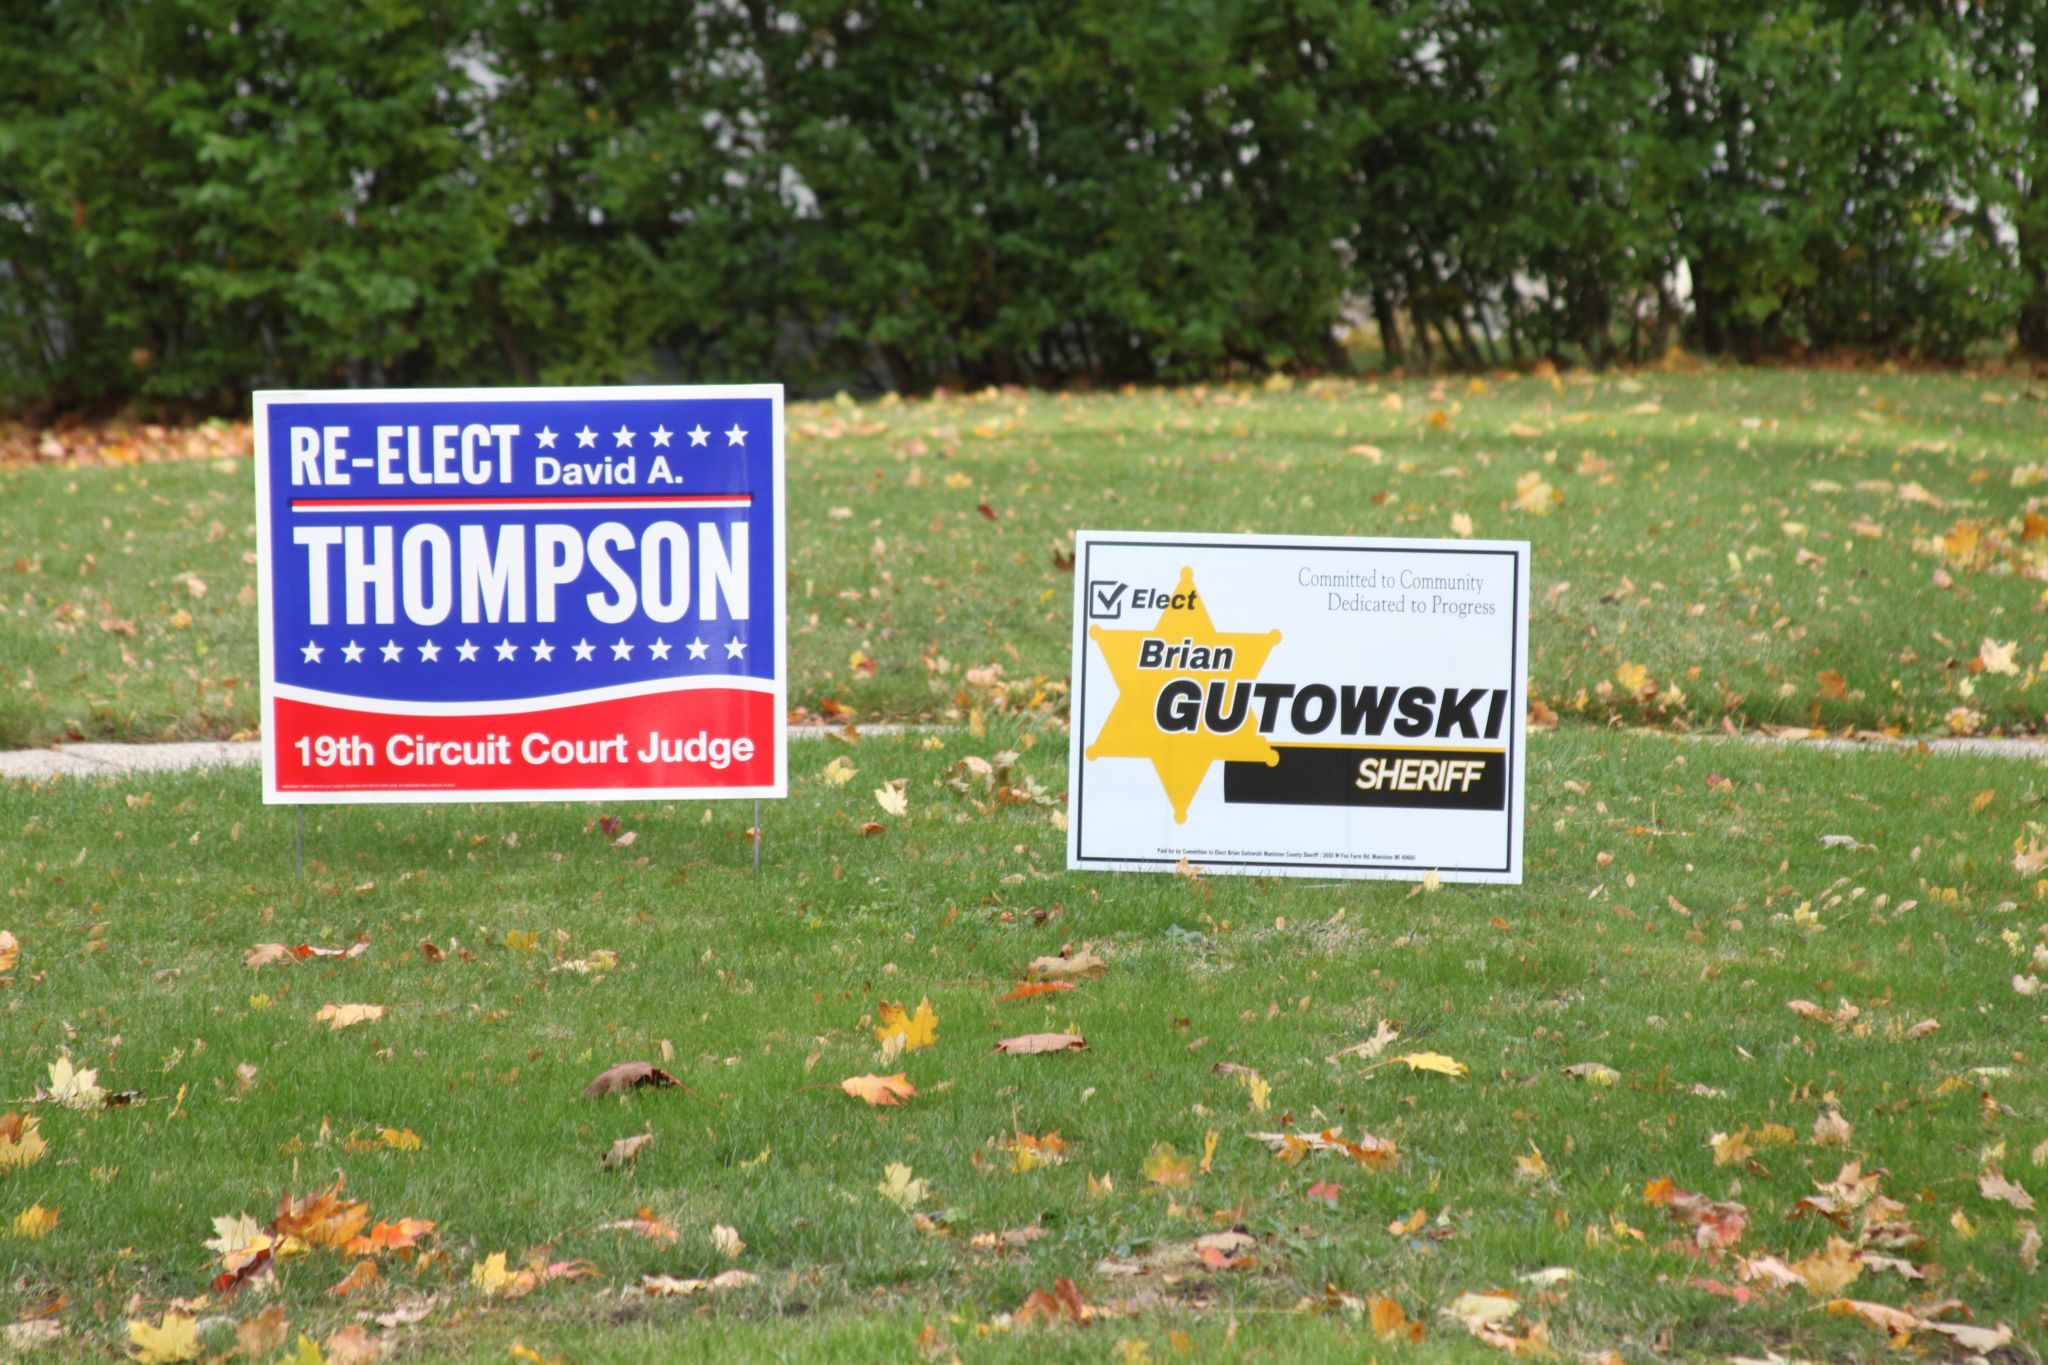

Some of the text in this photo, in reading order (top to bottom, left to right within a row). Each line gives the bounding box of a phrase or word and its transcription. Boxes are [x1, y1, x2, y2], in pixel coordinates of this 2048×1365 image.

[290, 423, 520, 486] RE-ELECT
[535, 455, 683, 485] David A.
[293, 520, 750, 626] THOMPSON
[1298, 566, 1484, 595] Committed to Community
[1131, 588, 1197, 610] Elect
[1328, 592, 1496, 619] Dedicated to Progress
[1138, 638, 1235, 671] Brian
[1155, 679, 1508, 739] GUTOWSKI
[294, 730, 755, 769] 19th Circuit Court Judge
[1355, 758, 1486, 793] SHERIFF
